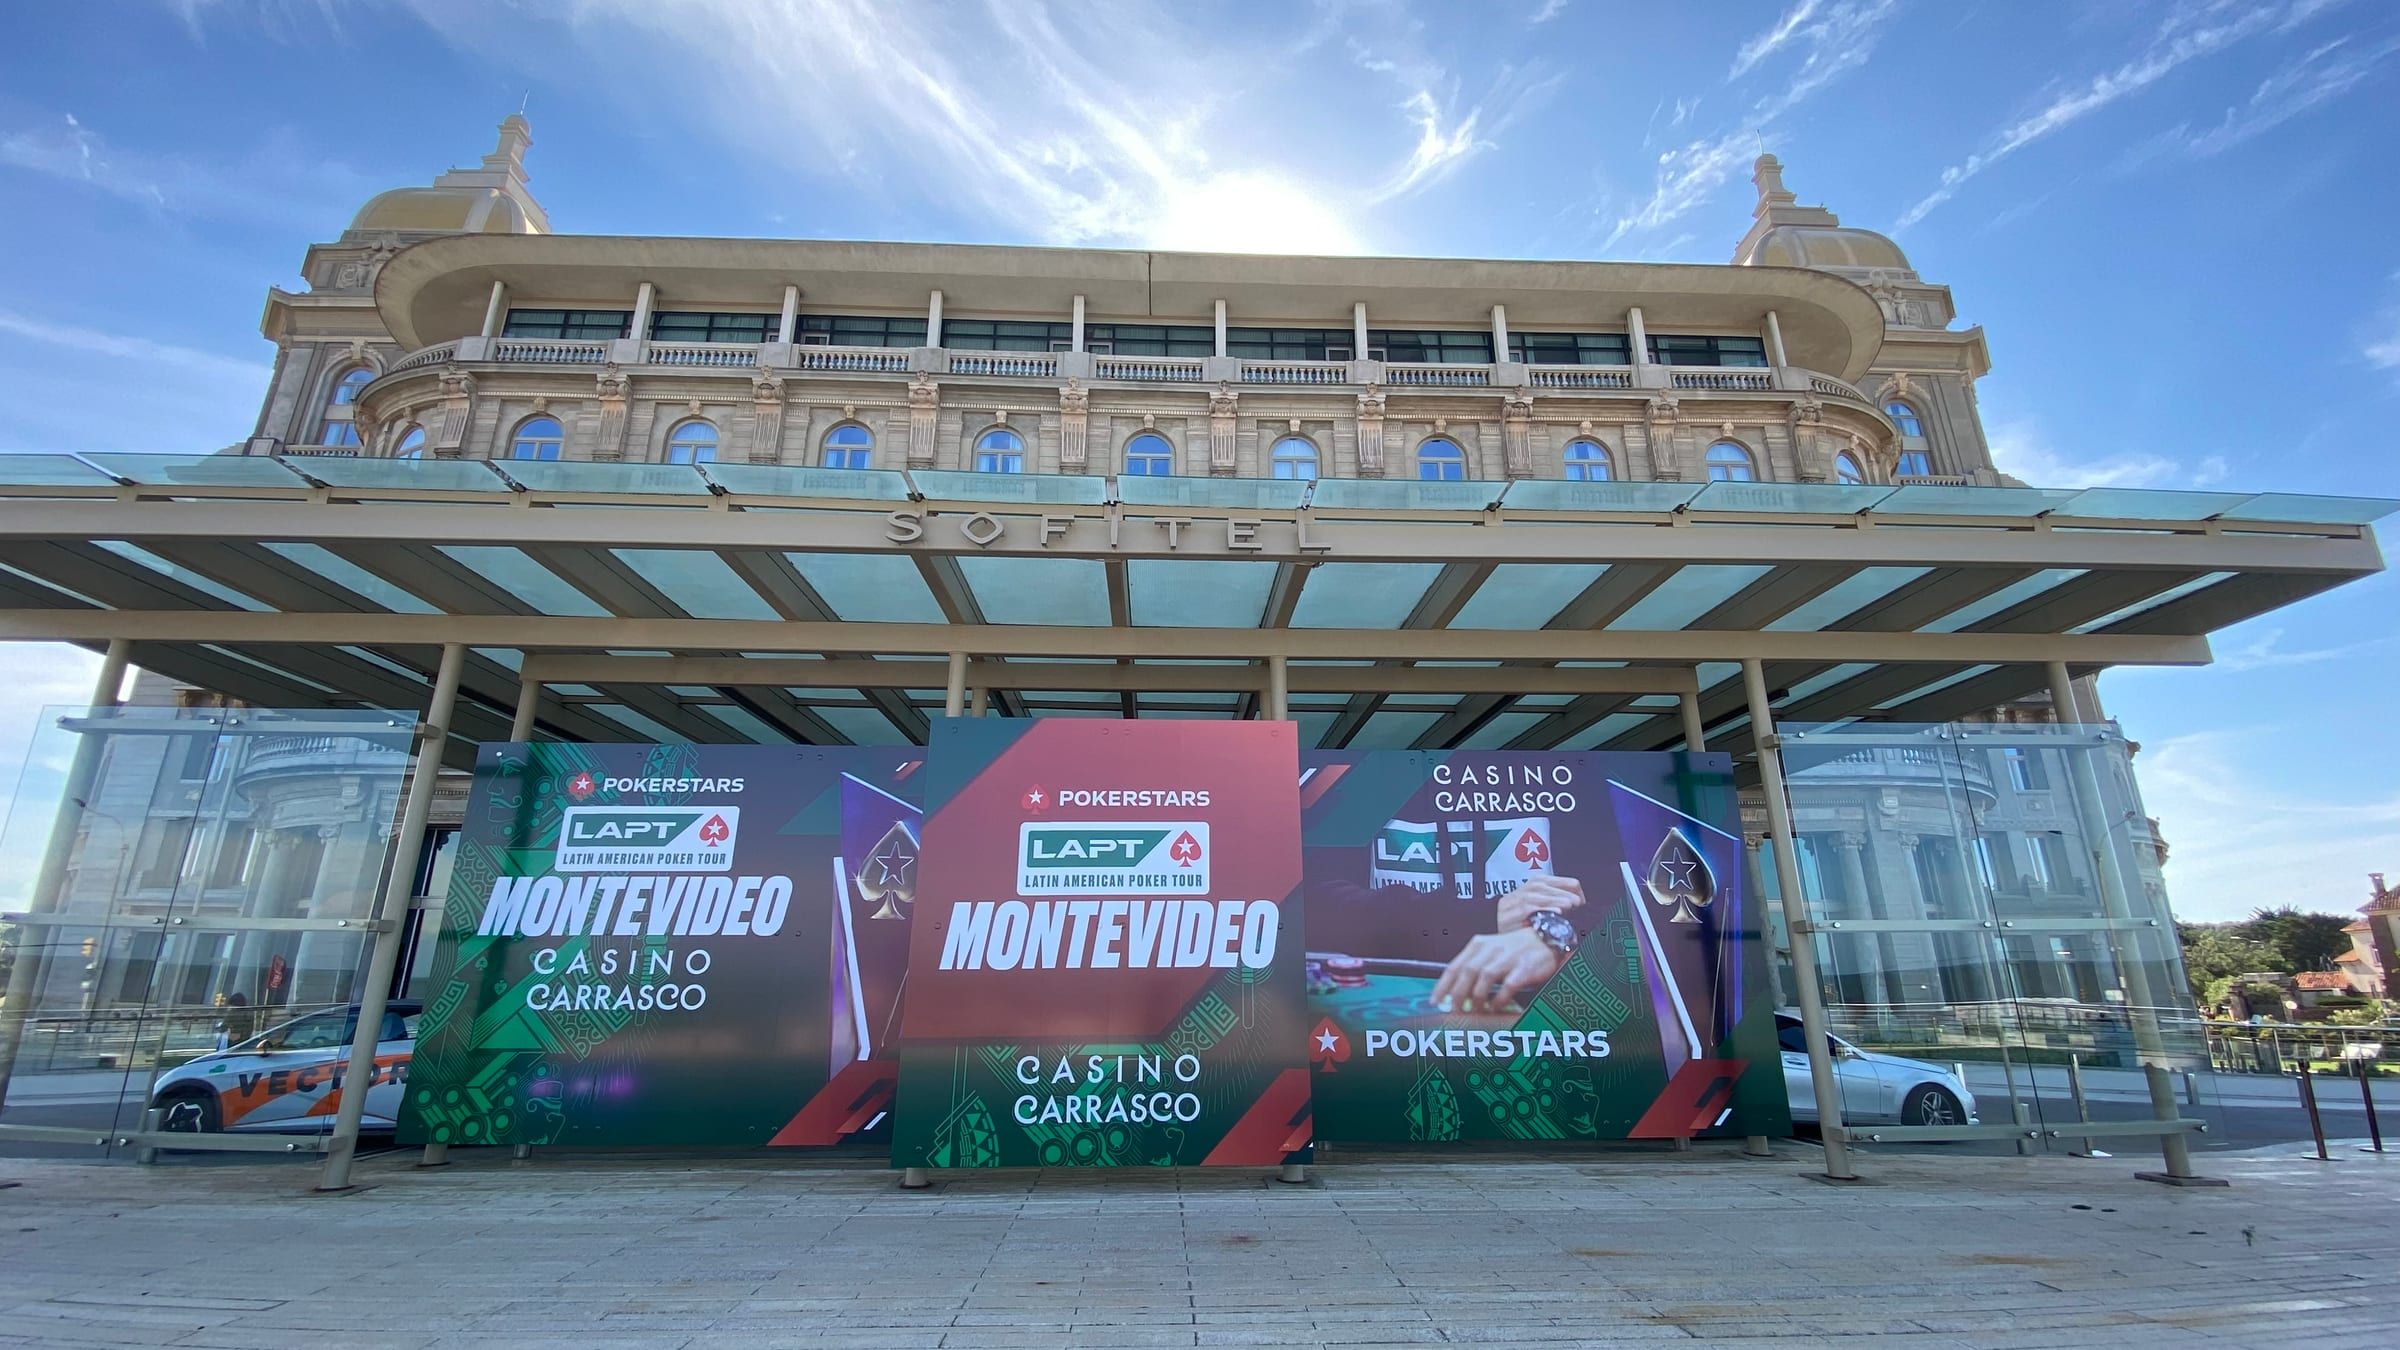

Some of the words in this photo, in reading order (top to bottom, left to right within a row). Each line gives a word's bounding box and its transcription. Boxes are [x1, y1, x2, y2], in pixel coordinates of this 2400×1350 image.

[884, 511, 1332, 552] SOFITEL
[602, 777, 745, 793] POKERSTARS
[1432, 764, 1573, 786] CASINO
[1059, 790, 1211, 807] POKERSTARS
[1435, 791, 1577, 813] CARRASCO
[573, 821, 677, 839] LAPT
[563, 853, 593, 865] LATIN
[597, 853, 654, 865] AMERICAN
[657, 853, 693, 865] POKER
[698, 853, 727, 865] TOUR
[1033, 839, 1144, 859] LAPT
[1025, 875, 1059, 888] LATIN
[1063, 875, 1124, 888] AMERICAN
[1129, 875, 1167, 887] POKER
[1172, 874, 1202, 887] TOUR
[1484, 879, 1517, 895] OKER
[477, 875, 793, 937] MONTEVIDEO
[939, 899, 1280, 970] MONTEVIDEO
[533, 948, 711, 975] CASINO
[526, 983, 707, 1011] CARRASCO
[1366, 1029, 1610, 1058] POKERSTARS
[1016, 1054, 1201, 1085] CASINO
[1013, 1091, 1201, 1125] CARRASCO
